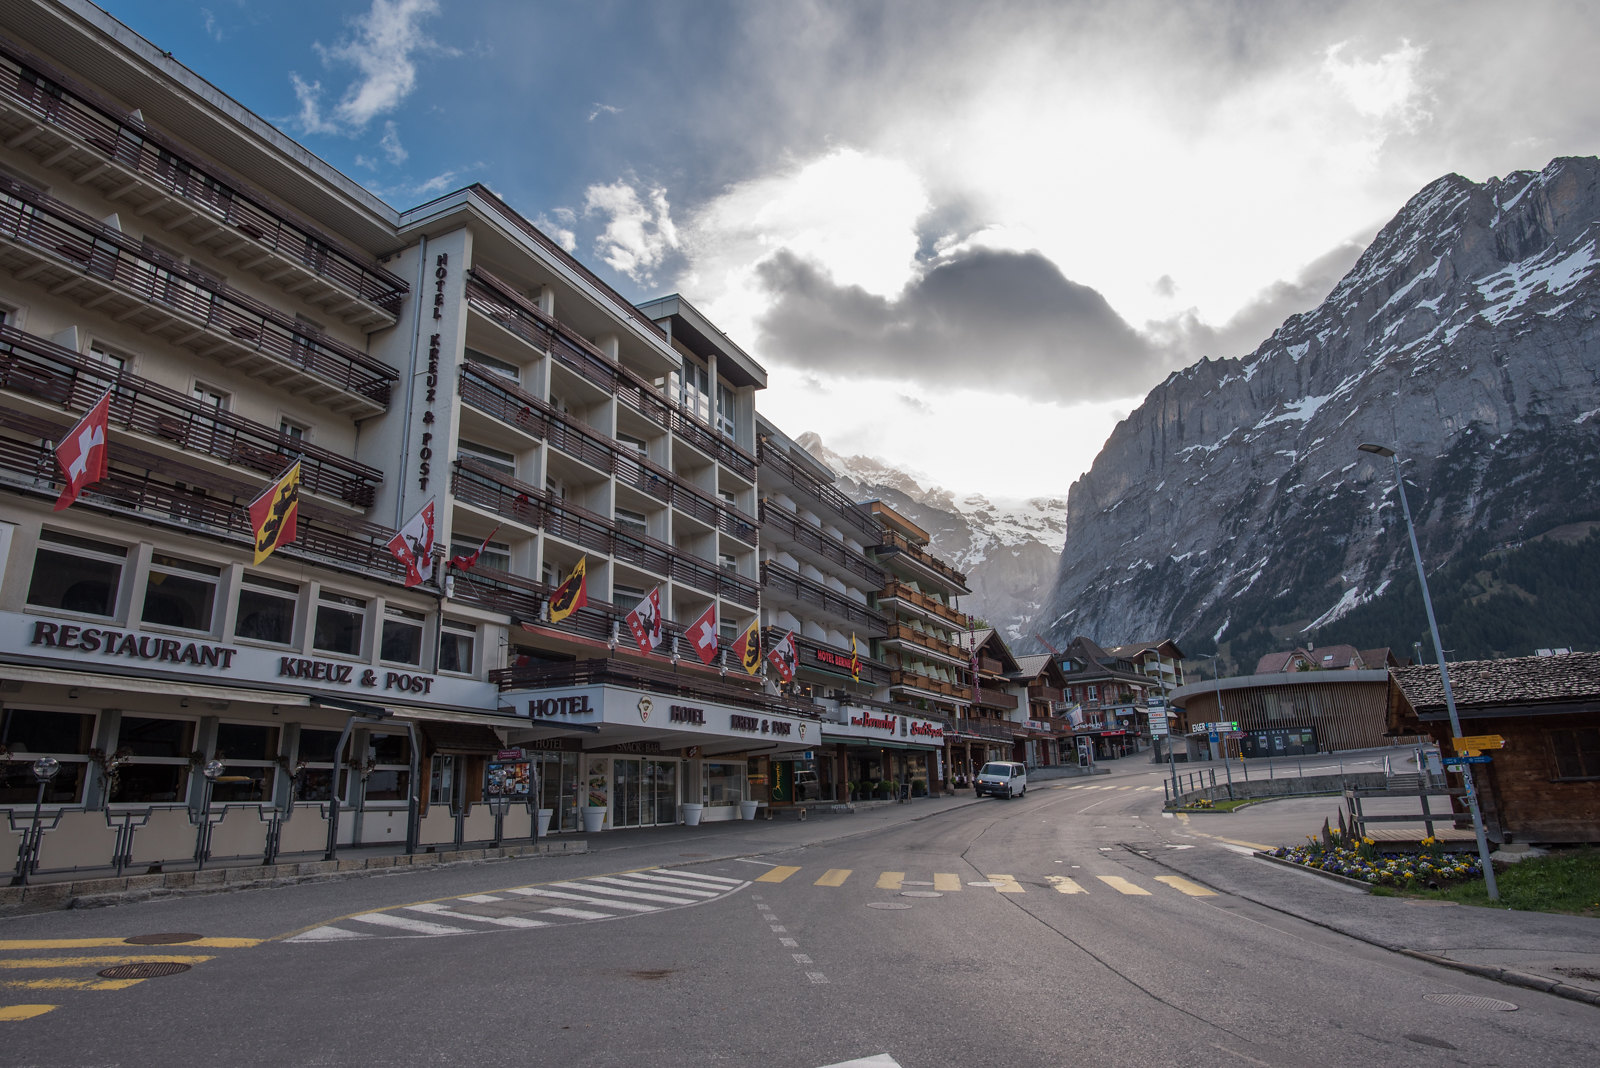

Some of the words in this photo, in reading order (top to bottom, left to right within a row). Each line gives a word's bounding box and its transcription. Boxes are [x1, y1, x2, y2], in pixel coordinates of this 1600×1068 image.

[433, 253, 448, 320] HOTEL
[425, 333, 440, 402] KREUZ
[422, 411, 435, 424] &
[419, 432, 433, 491] POST
[968, 615, 976, 653] HOTEL
[31, 621, 238, 669] RESTAURANT
[280, 656, 353, 684] KREUZ
[361, 669, 378, 687] &
[386, 671, 435, 695] POST
[817, 649, 835, 665] HOTEL
[528, 695, 593, 718] HOTEL
[671, 705, 706, 725] HOTEL
[731, 714, 759, 731] KREUZ
[762, 719, 769, 732] &
[772, 720, 792, 735] POST
[863, 711, 897, 735] Bernerhof
[1192, 722, 1206, 733] EIGER
[535, 739, 563, 750] HOTEL
